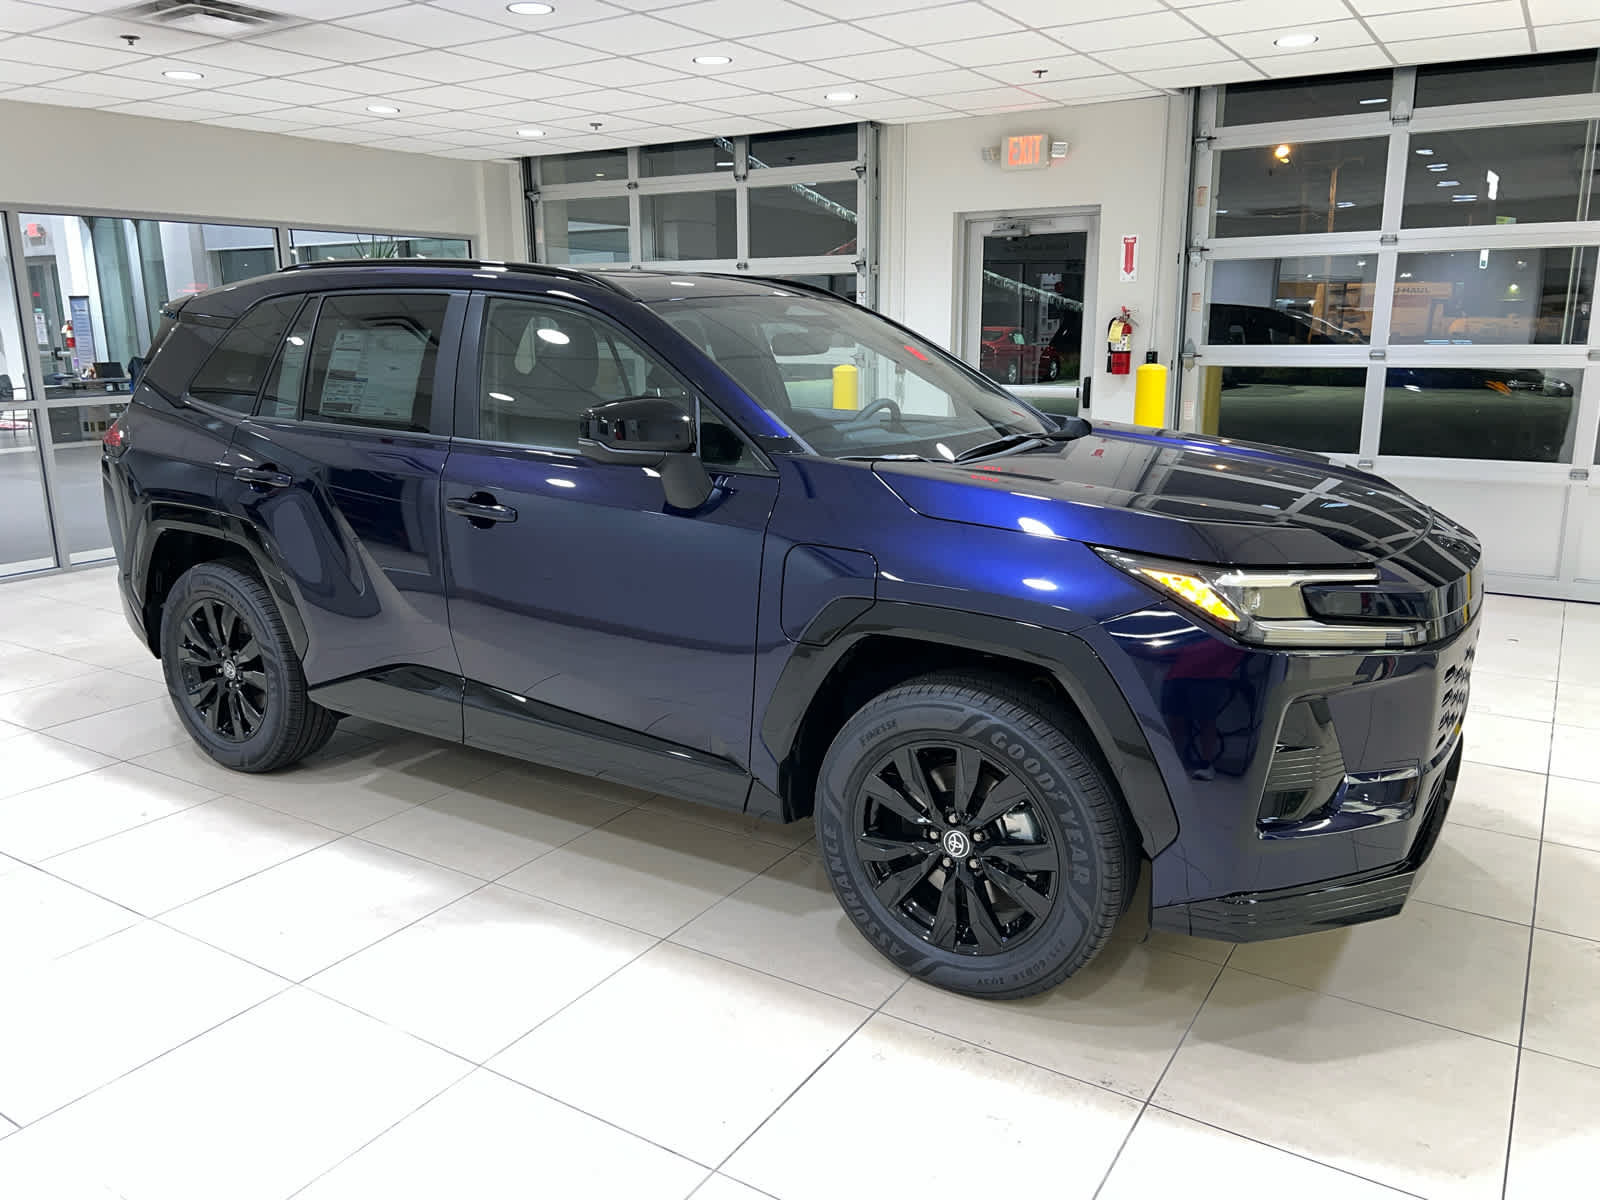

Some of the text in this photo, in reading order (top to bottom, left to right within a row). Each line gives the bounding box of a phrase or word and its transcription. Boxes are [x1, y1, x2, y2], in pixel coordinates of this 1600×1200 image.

[1008, 135, 1043, 165] EXIT
[991, 732, 1090, 884] GOODYEAR
[823, 822, 904, 954] ASSURANCE
